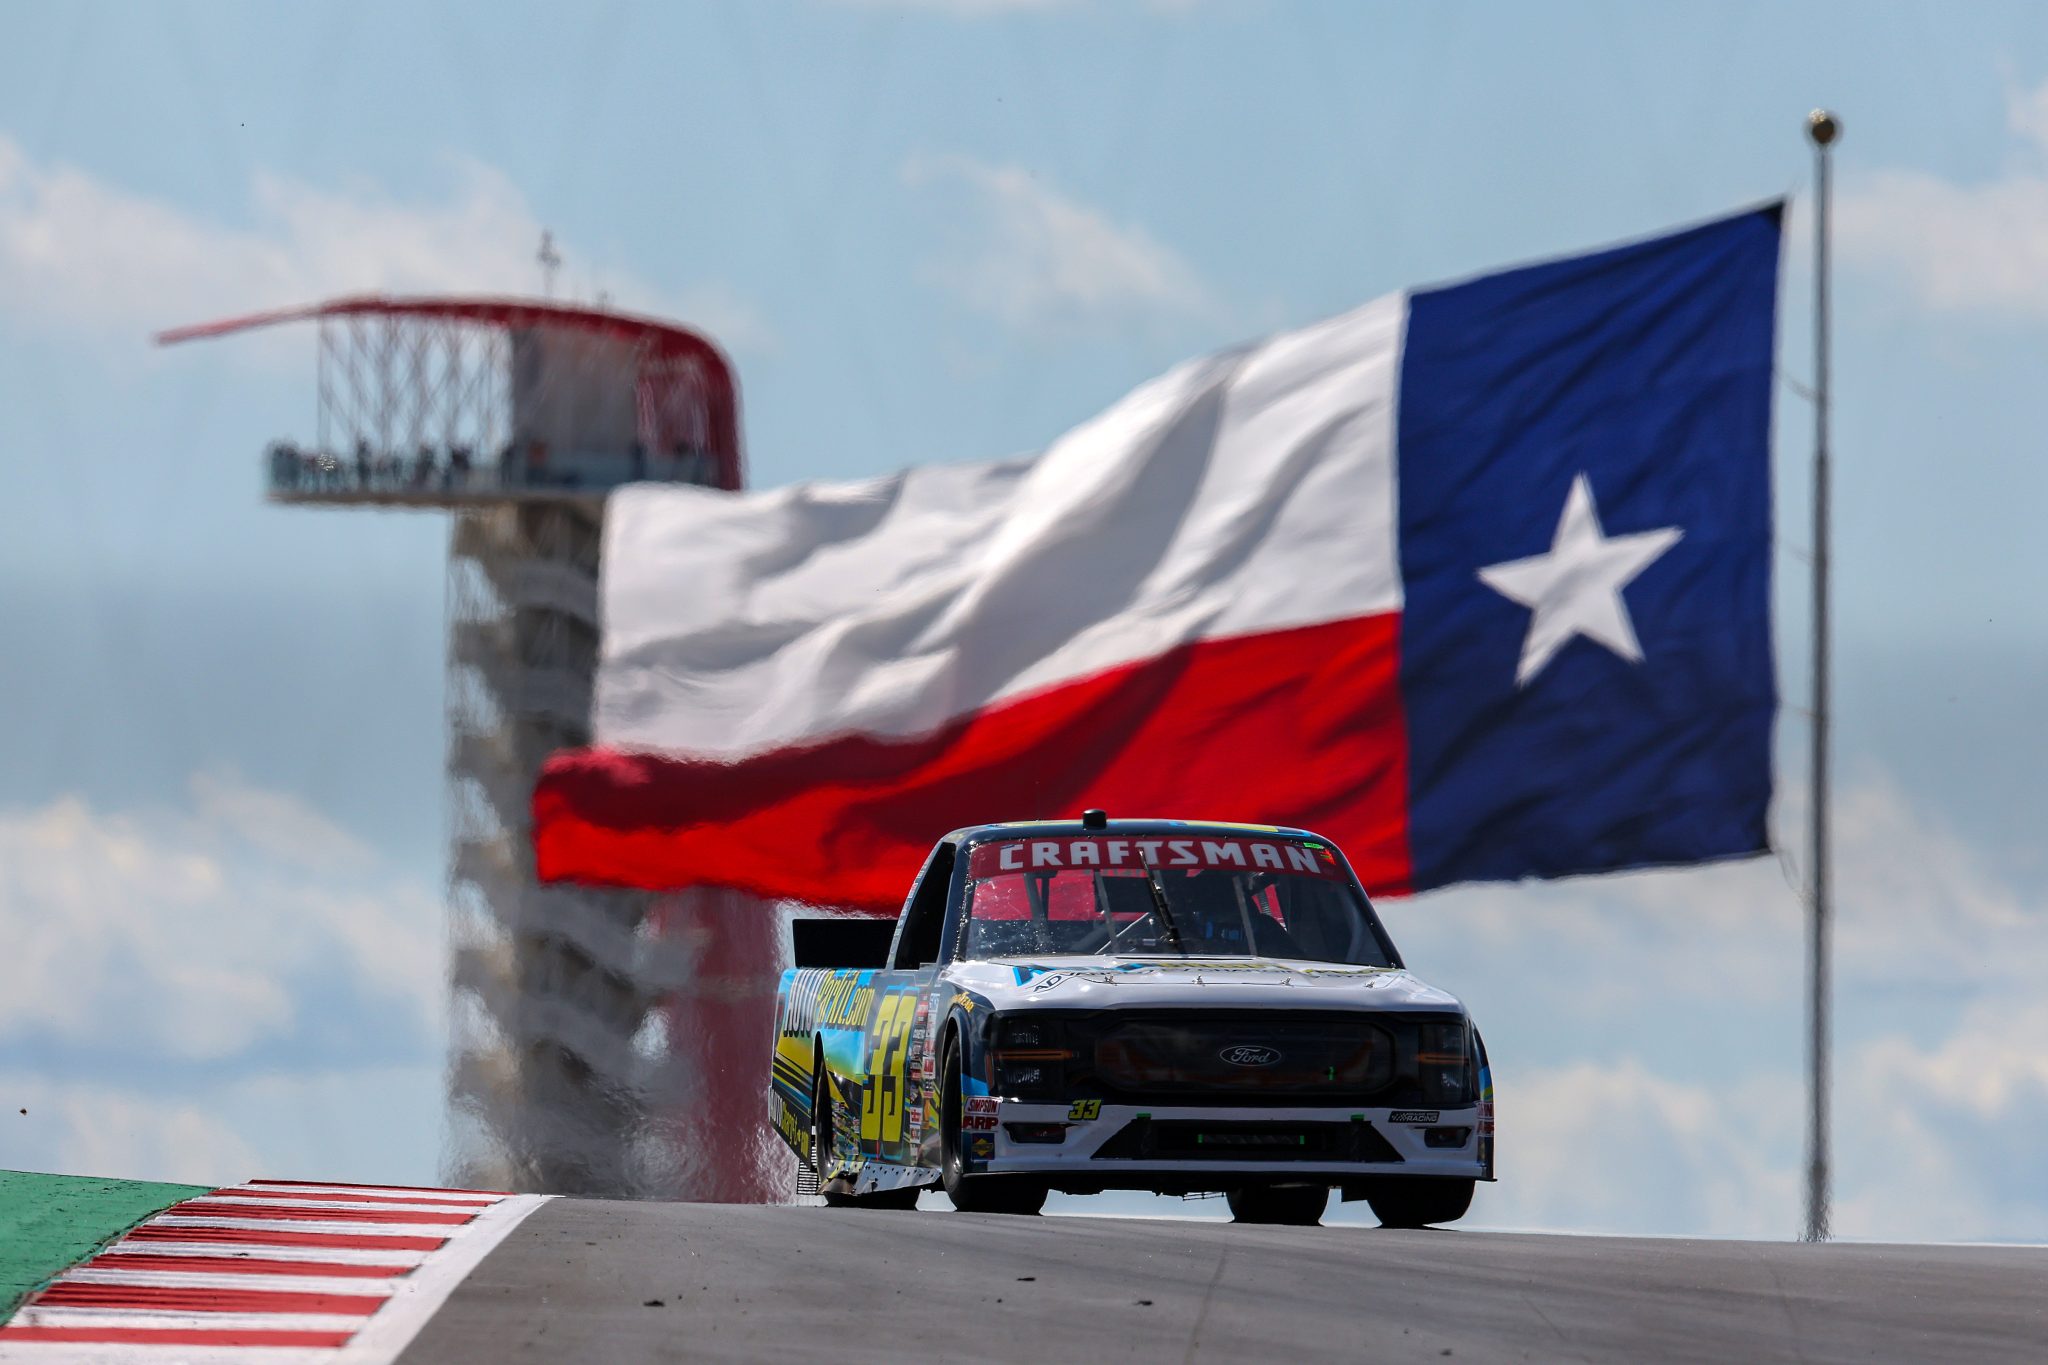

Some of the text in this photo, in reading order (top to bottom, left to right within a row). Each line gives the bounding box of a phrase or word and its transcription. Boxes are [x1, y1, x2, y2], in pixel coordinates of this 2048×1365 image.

[1000, 841, 1321, 873] CRAFTSMAN
[1231, 1047, 1271, 1063] Ford
[860, 995, 917, 1142] 33
[968, 1100, 998, 1113] SIMPSON
[1068, 1100, 1101, 1120] 33
[961, 1116, 998, 1129] ARP
